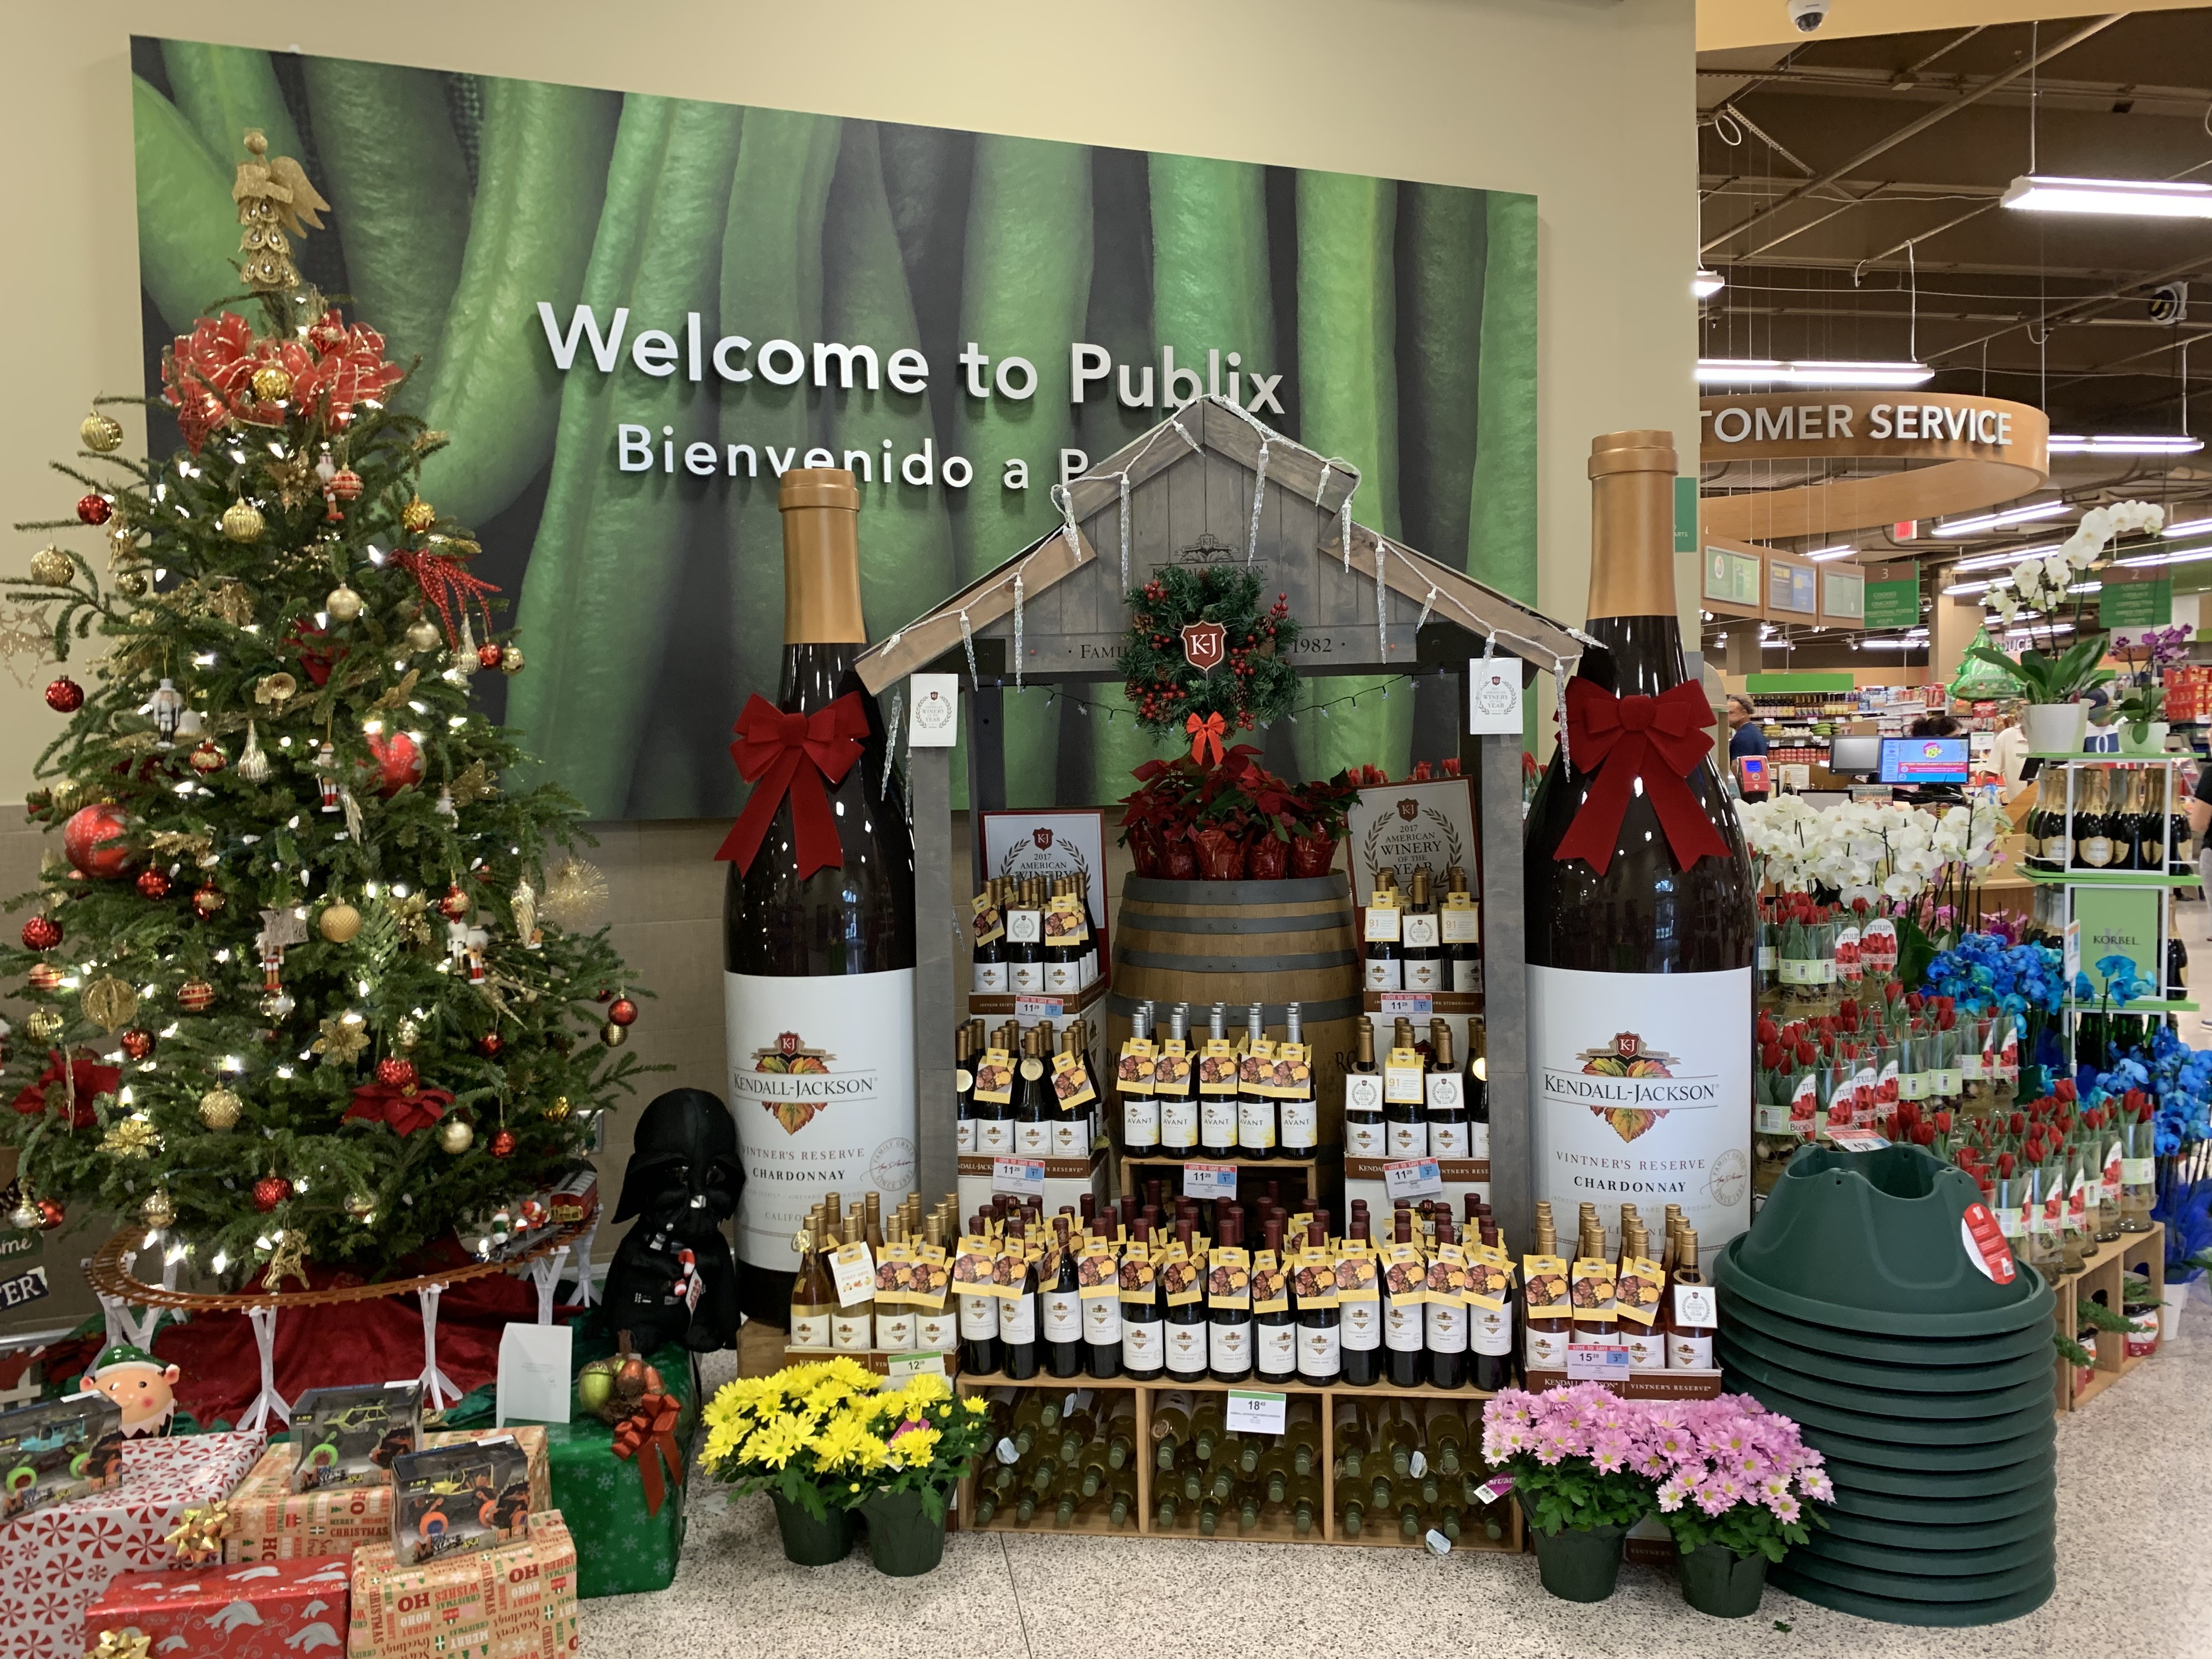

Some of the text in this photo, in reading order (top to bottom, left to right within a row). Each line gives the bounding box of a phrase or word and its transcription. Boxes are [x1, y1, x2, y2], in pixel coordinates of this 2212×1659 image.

[538, 301, 1285, 414] Welcome to Publix
[1868, 404, 2013, 446] SERVICE
[618, 423, 973, 488] Bienvenido
[1003, 456, 1029, 489] a
[1882, 568, 1889, 579] 3
[2131, 569, 2139, 580] 2
[1190, 633, 1218, 658] K-J
[1292, 637, 1332, 653] 1982
[1400, 824, 1418, 833] 2017
[1386, 832, 1435, 843] AMERICAN
[1380, 840, 1442, 856] WINERY
[1020, 861, 1067, 870] AMERICAN
[1015, 870, 1073, 880] WINRY
[2093, 935, 2139, 945] KORBEL
[782, 1037, 795, 1051] K-J
[1620, 1038, 1636, 1052] K-J
[733, 1073, 873, 1099] KENDALL-JACKSON
[1389, 1077, 1400, 1087] 91
[1544, 1074, 1716, 1105] KENDALL-JACKSON
[1239, 1118, 1263, 1126] AVANT
[1284, 1118, 1310, 1126] AVANT
[742, 1147, 865, 1161] VINTNER'S RESERVE
[1556, 1150, 1706, 1171] VINTNER'S RESERVE
[753, 1167, 846, 1181] CHARDONNAY
[1574, 1176, 1686, 1193] CHARDONNAY
[765, 1211, 802, 1222] CALIFO
[330, 1527, 389, 1537] CHRISTMAS
[543, 1554, 574, 1573] ISHES
[509, 1562, 539, 1584] HO
[435, 1582, 479, 1602] WISHES
[398, 1592, 430, 1612] HO
